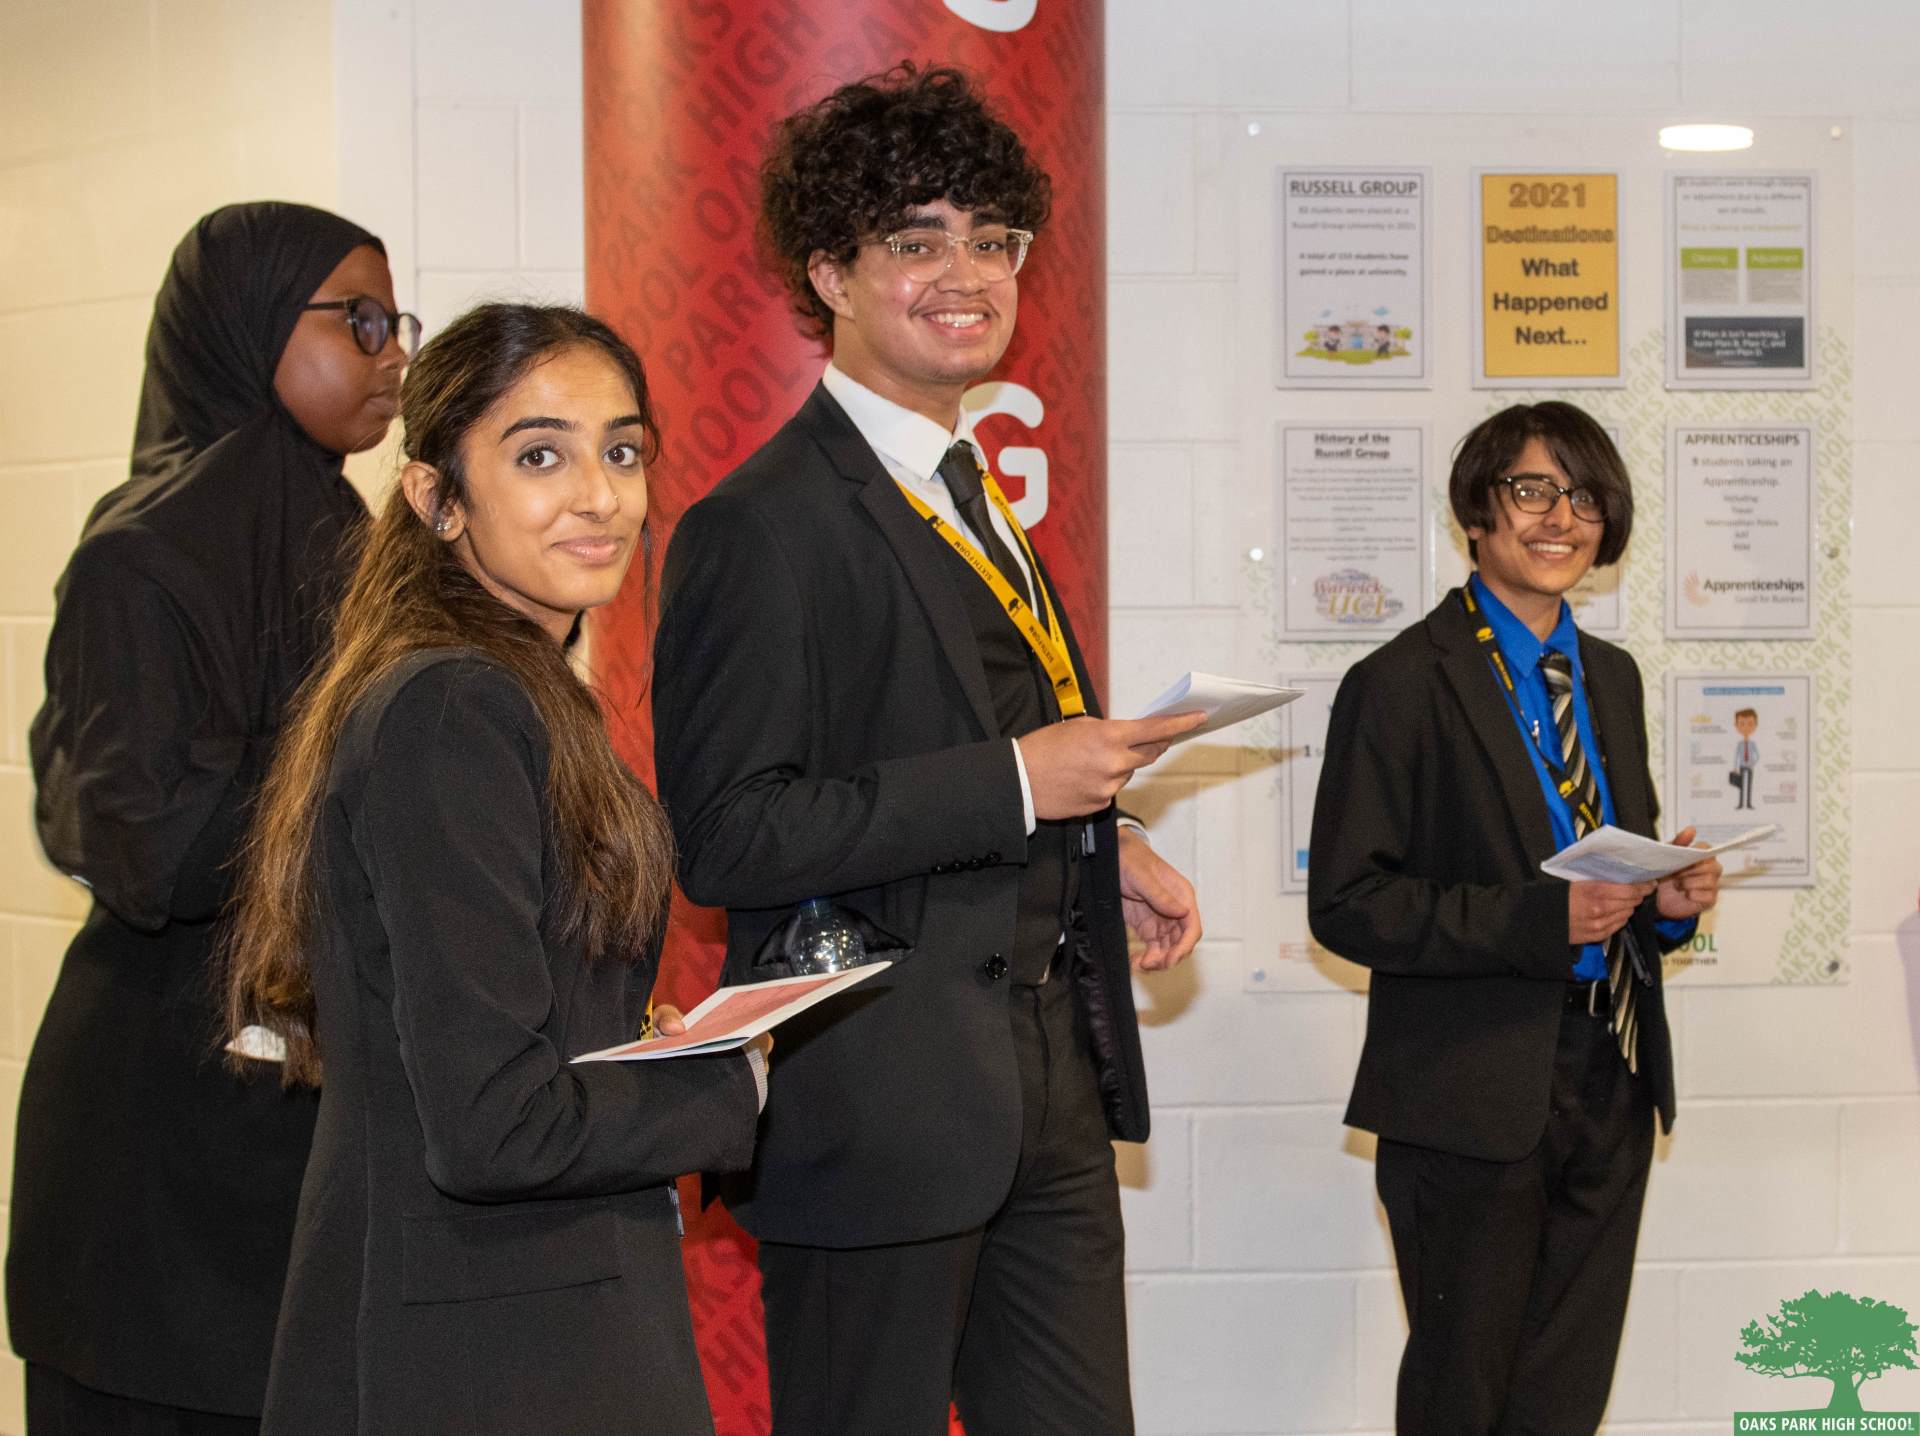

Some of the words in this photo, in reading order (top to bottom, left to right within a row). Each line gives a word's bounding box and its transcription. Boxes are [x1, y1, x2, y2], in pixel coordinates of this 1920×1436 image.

[685, 0, 824, 148] HIGH
[1290, 180, 1356, 195] RUSSELL
[1360, 180, 1418, 195] GROUP
[1508, 182, 1586, 208] 2021
[1486, 225, 1614, 244] Destinations
[1521, 258, 1579, 277] What
[1493, 292, 1608, 315] Happened
[1515, 326, 1587, 345] Next...
[666, 345, 803, 499] HOOL
[1314, 434, 1355, 445] History
[1358, 434, 1369, 445] of
[1372, 434, 1390, 445] the
[1685, 434, 1800, 446] APPRENTICESHIPS
[1314, 448, 1352, 459] Russell
[1355, 448, 1390, 459] Group
[954, 540, 976, 563] FORM
[972, 559, 994, 582] SIXTH
[1704, 578, 1805, 593] Apprenticeships
